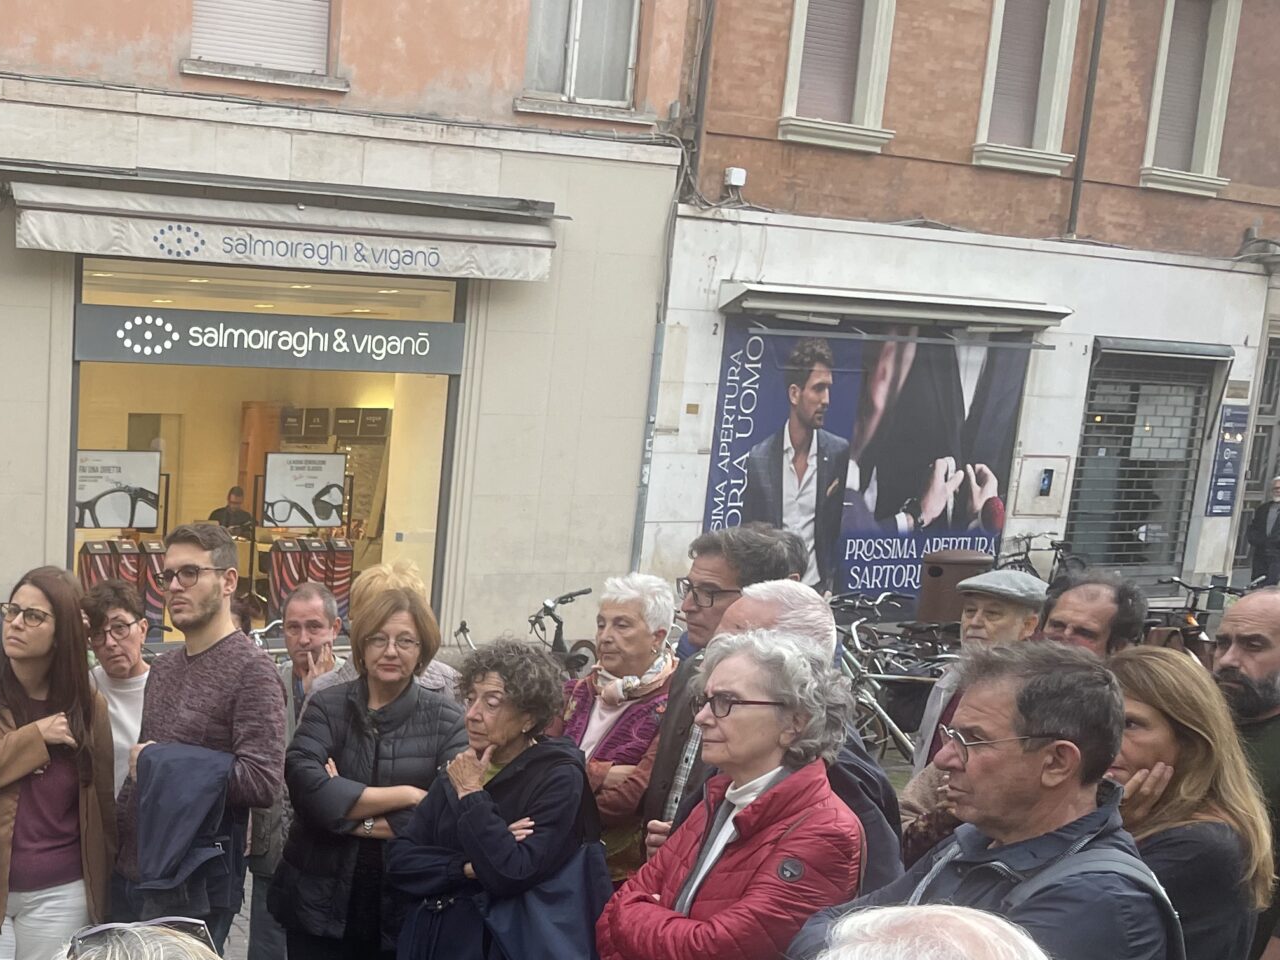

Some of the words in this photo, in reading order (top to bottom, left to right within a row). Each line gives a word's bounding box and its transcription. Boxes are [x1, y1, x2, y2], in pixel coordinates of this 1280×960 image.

[222, 234, 347, 266] salmoiraghi
[353, 242, 368, 263] &
[188, 322, 329, 358] salmoiraghi
[332, 328, 350, 353] &
[711, 322, 719, 336] 2
[735, 335, 765, 439] UOMO
[717, 349, 744, 473] APERTURA
[710, 480, 728, 531] SIMA
[725, 451, 750, 529] ORIA
[844, 537, 917, 562] PROSSIMA
[848, 564, 922, 590] SARTORI
